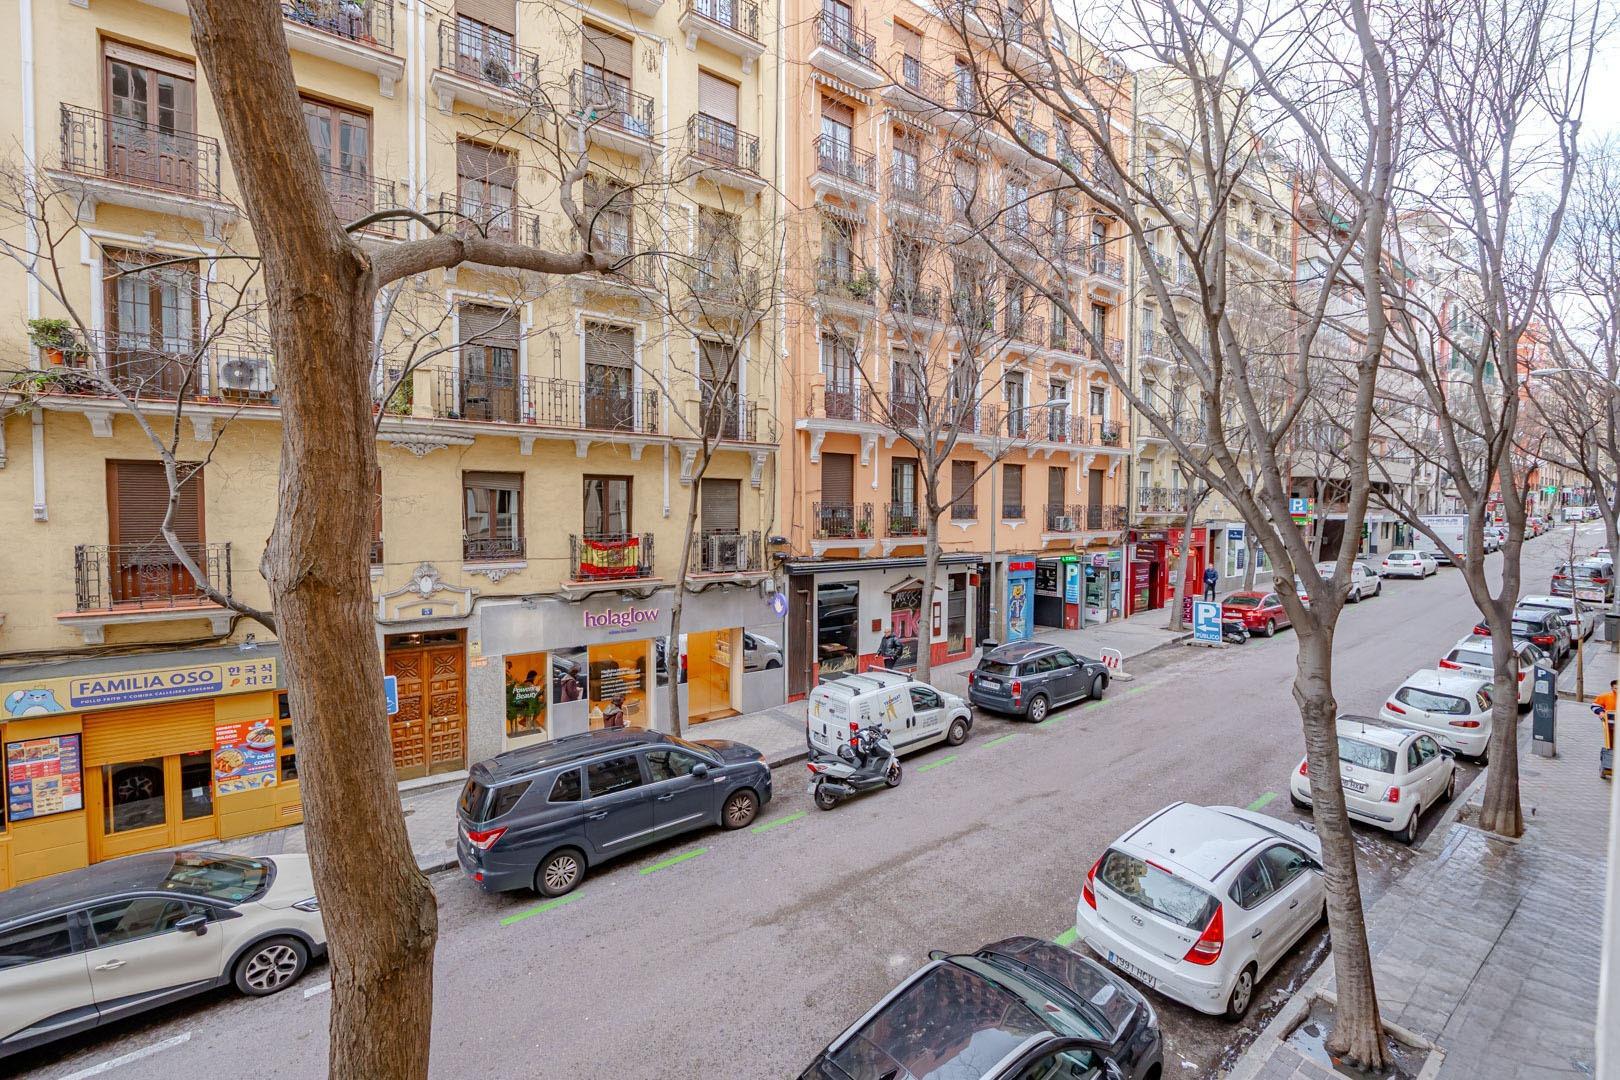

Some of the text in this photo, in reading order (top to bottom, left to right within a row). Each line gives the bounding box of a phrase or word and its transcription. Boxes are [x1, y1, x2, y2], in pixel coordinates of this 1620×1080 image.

[584, 607, 659, 628] holaglow
[1198, 604, 1217, 624] P
[79, 670, 214, 695] FAMILIA OSO
[1537, 669, 1546, 677] P
[515, 692, 538, 700] Beauty
[1115, 954, 1134, 972] 1991
